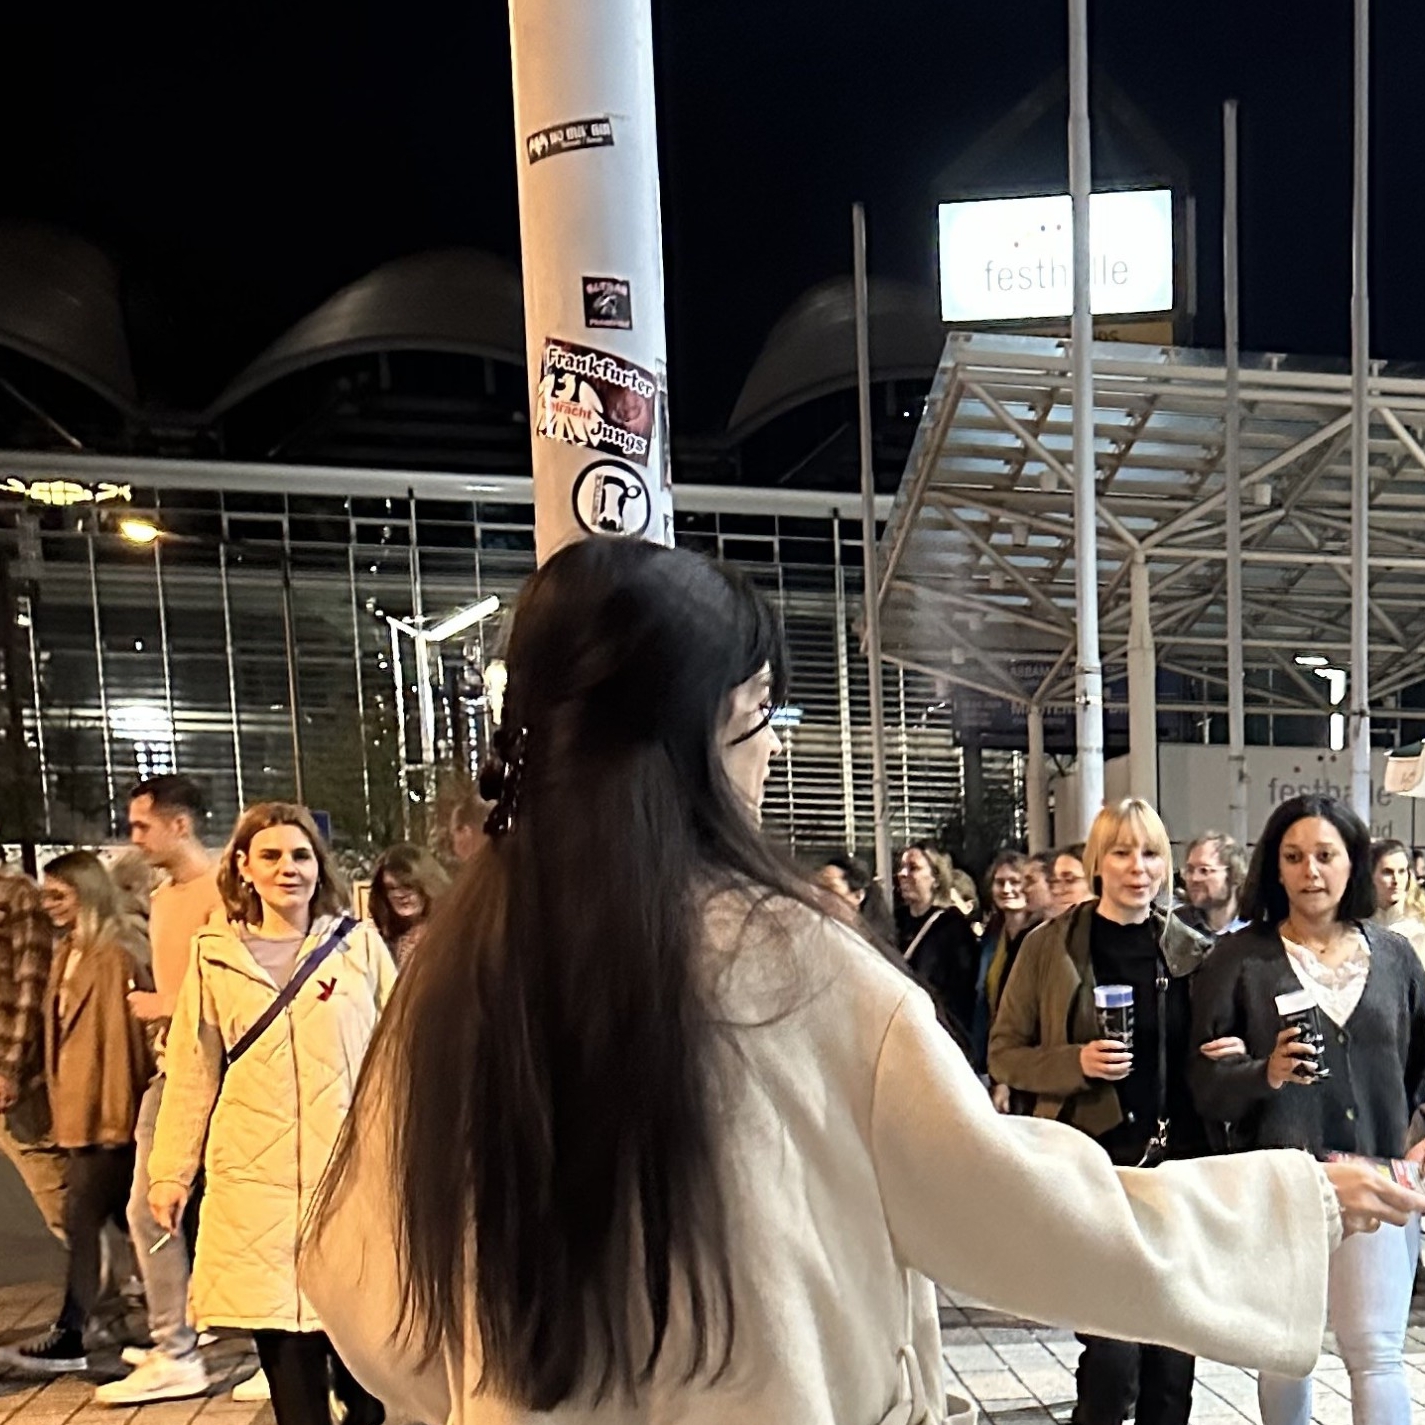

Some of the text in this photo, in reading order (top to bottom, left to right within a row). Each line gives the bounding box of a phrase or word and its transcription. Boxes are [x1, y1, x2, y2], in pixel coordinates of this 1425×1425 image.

[985, 254, 1128, 292] festhlle
[546, 344, 655, 398] Frankfurter
[541, 399, 592, 420] Etracht
[590, 420, 648, 454] Jungs
[1267, 777, 1393, 806] festhle
